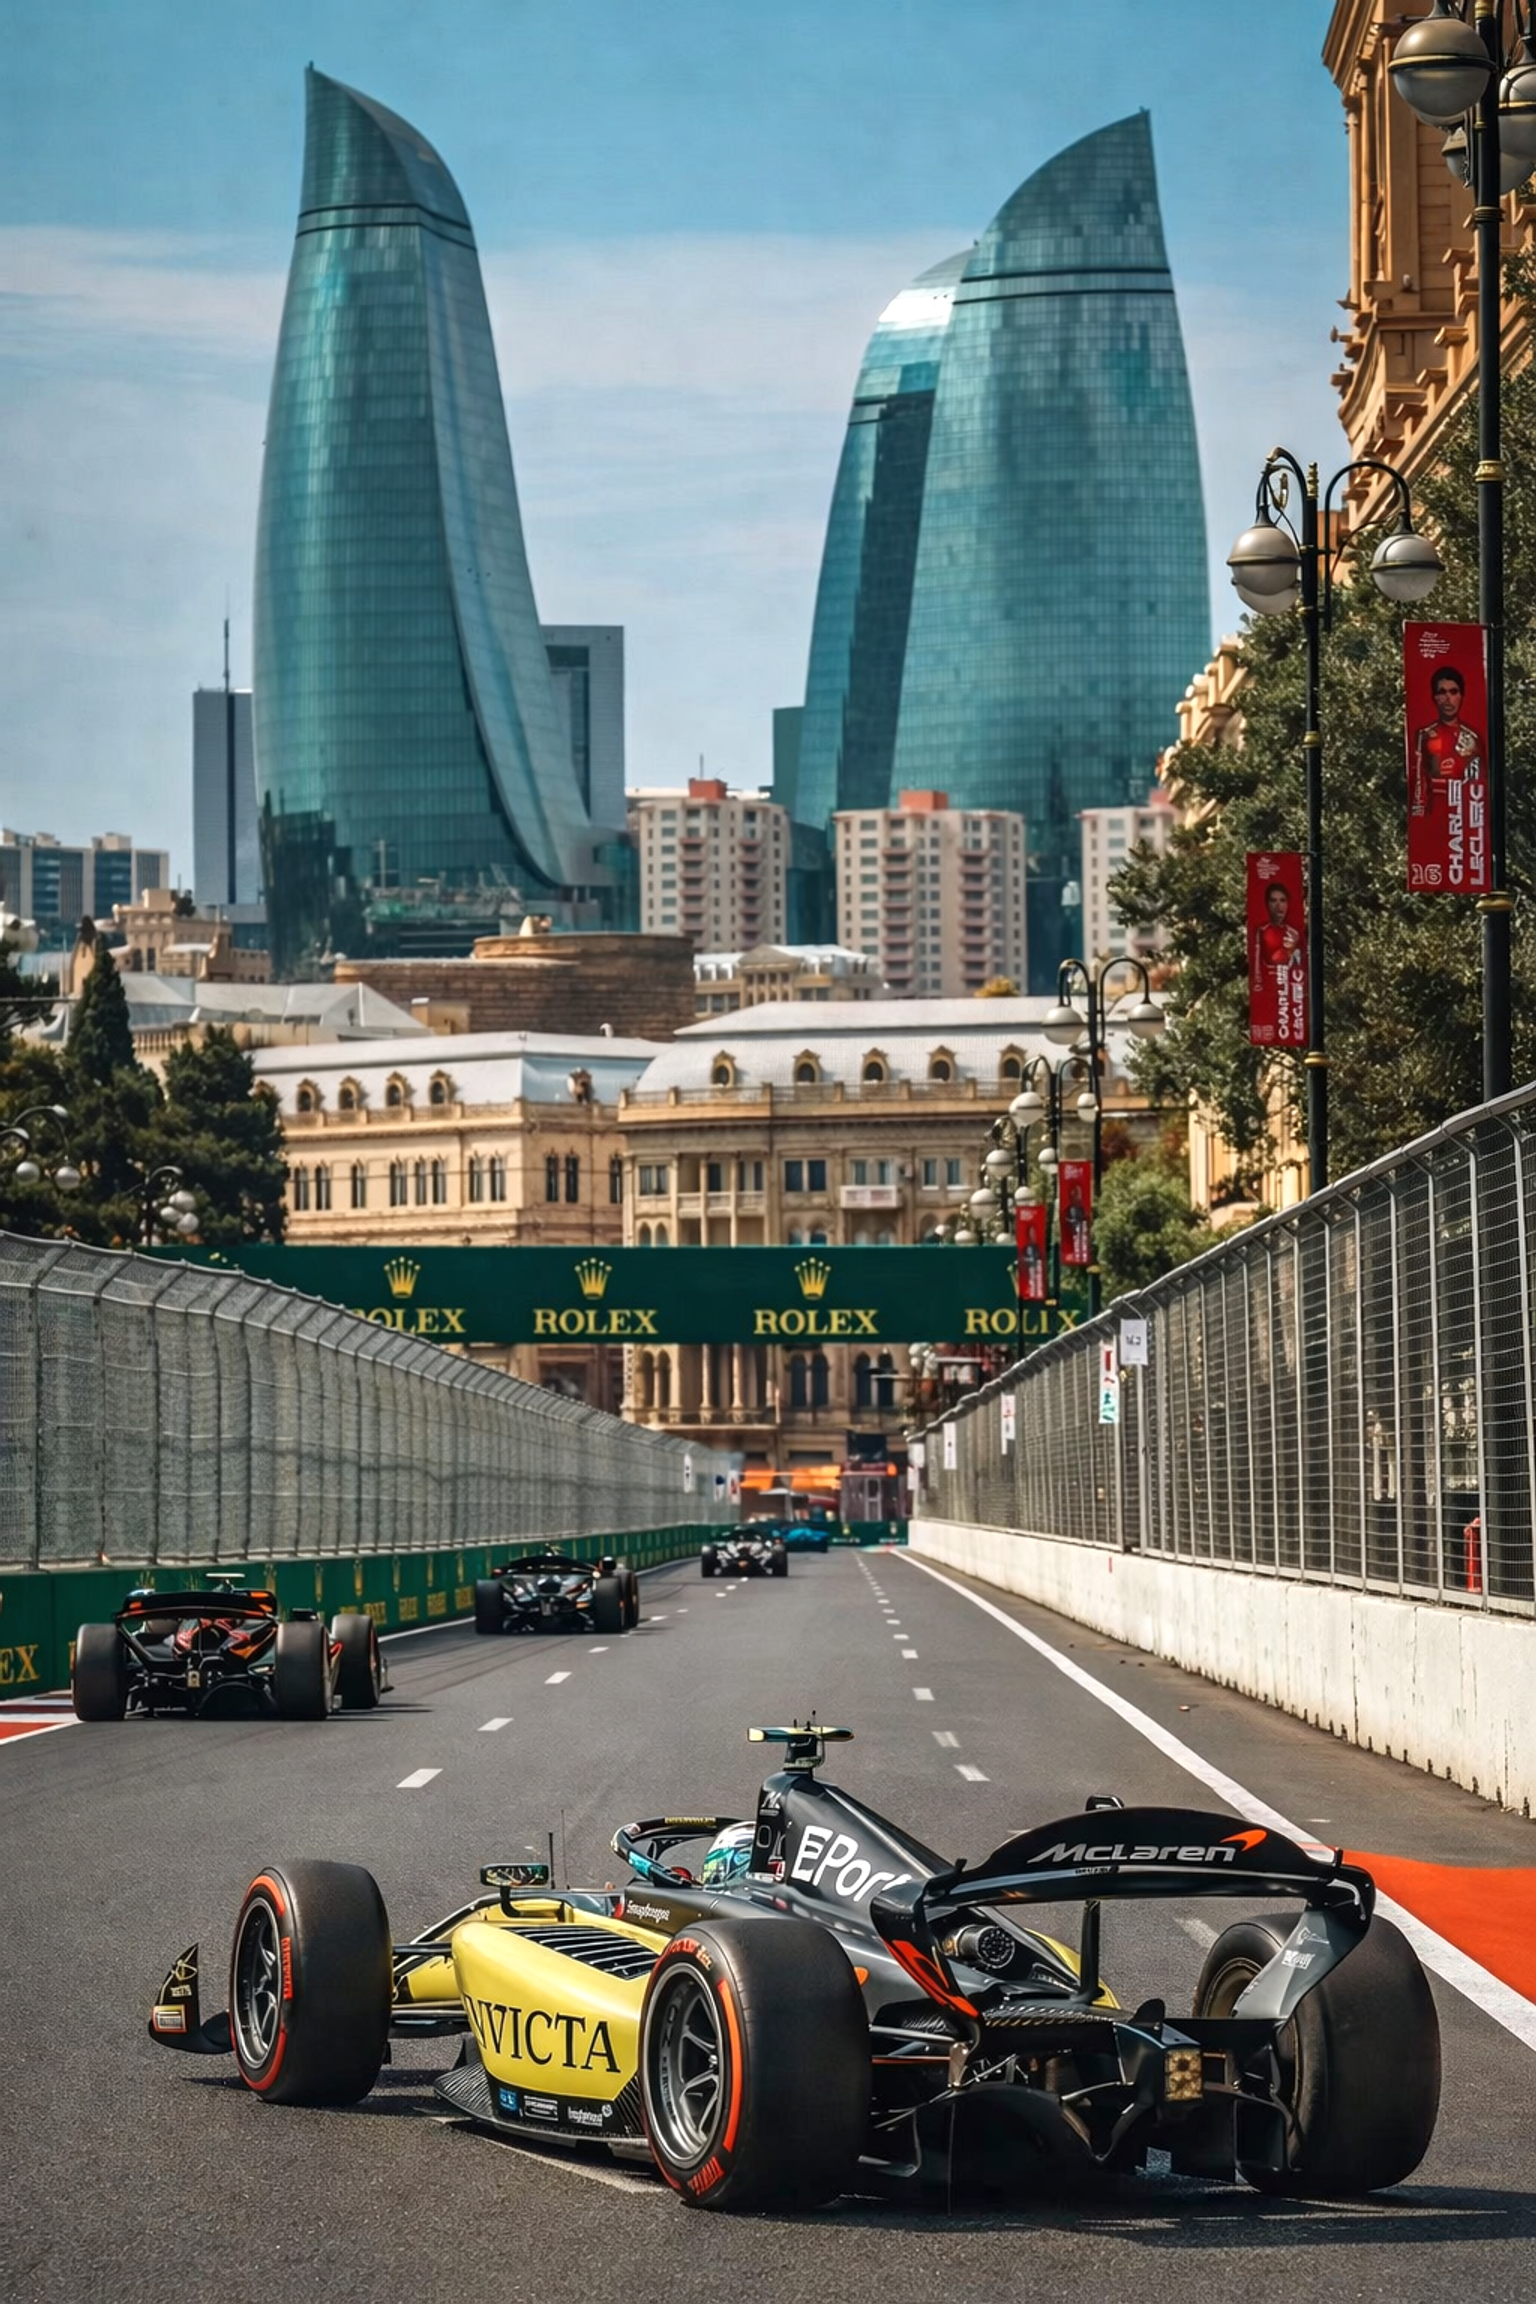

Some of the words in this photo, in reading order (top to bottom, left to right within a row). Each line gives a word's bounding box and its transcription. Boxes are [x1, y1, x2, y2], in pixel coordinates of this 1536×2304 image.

[352, 1308, 467, 1335] OLEX
[533, 1308, 658, 1335] ROLEX
[753, 1309, 879, 1335] ROLEX
[1026, 1842, 1236, 1864] McLaren
